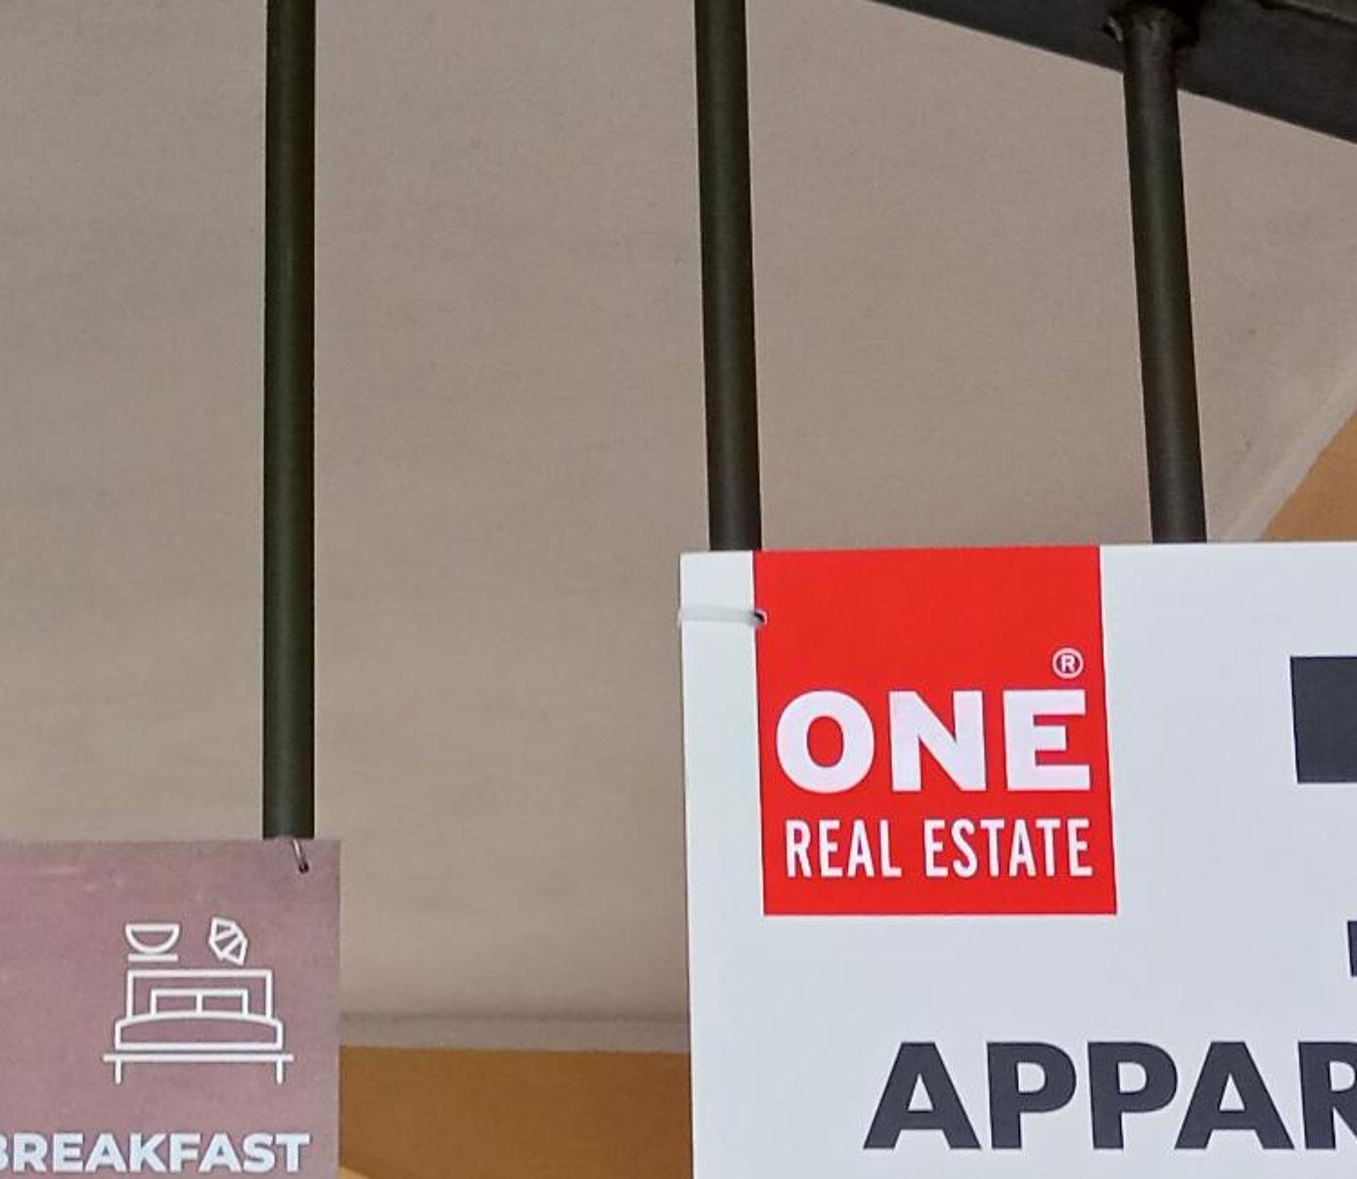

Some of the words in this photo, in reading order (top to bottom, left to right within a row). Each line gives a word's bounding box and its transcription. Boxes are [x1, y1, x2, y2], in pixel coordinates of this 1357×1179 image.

[776, 689, 1091, 794] ONE
[785, 819, 902, 878] REAL
[923, 818, 1093, 877] ESTATE
